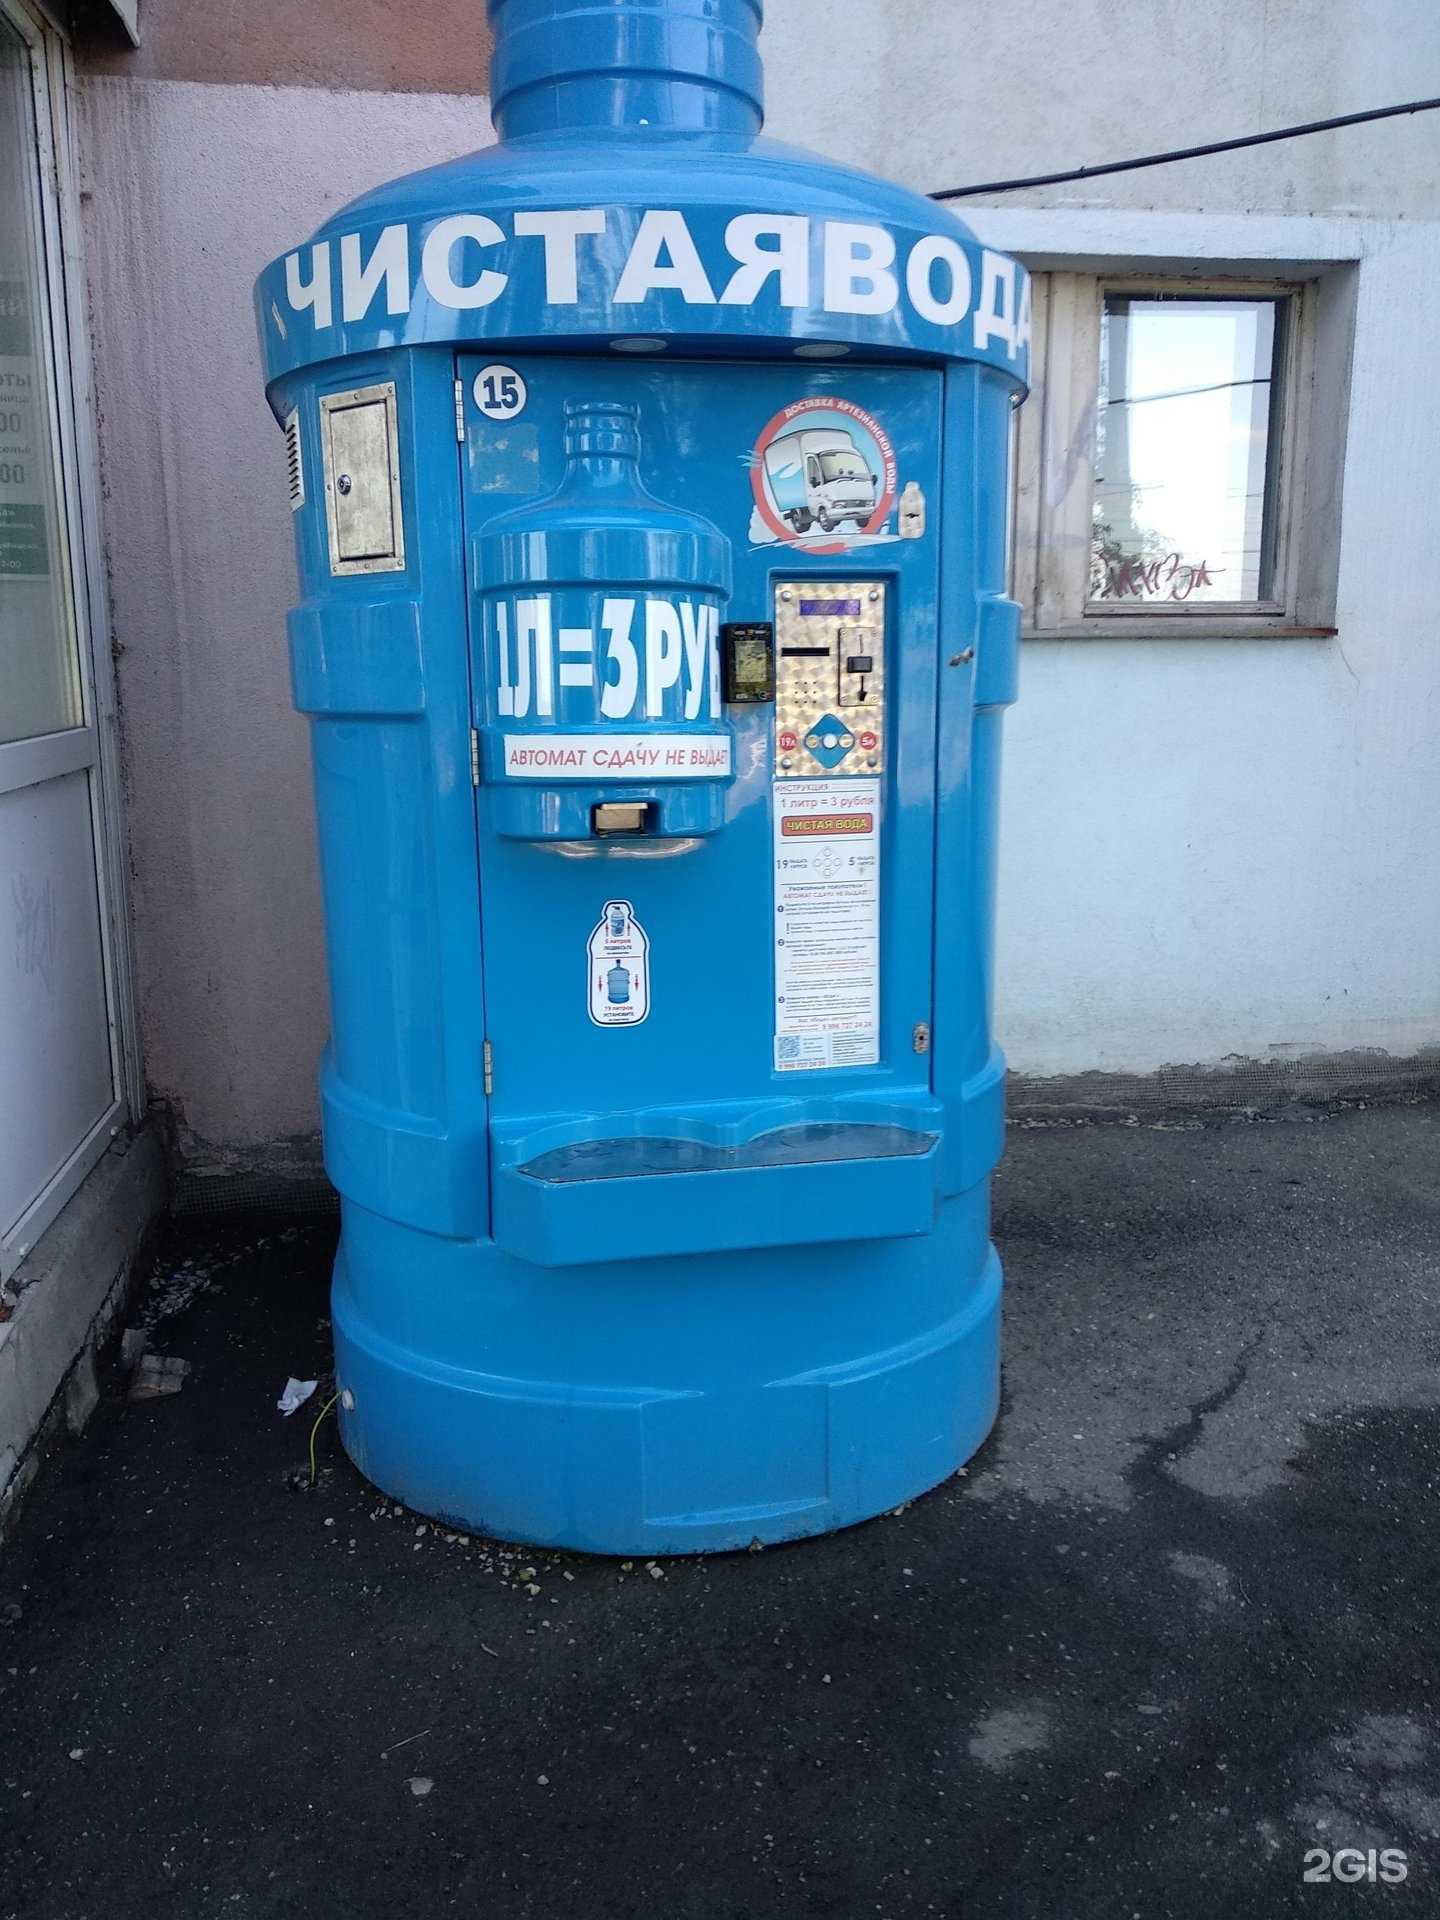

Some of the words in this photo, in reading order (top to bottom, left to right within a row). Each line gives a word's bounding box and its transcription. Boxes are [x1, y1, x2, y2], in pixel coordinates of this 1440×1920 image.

[483, 375, 519, 409] 15
[784, 398, 834, 419] ДОСТАВКА
[510, 749, 586, 766] АВТОМАТ
[592, 748, 660, 769] СДАЧУ
[665, 749, 686, 765] НЕ
[787, 819, 833, 831] ЧИСТАЯ
[836, 817, 867, 830] ВОДА
